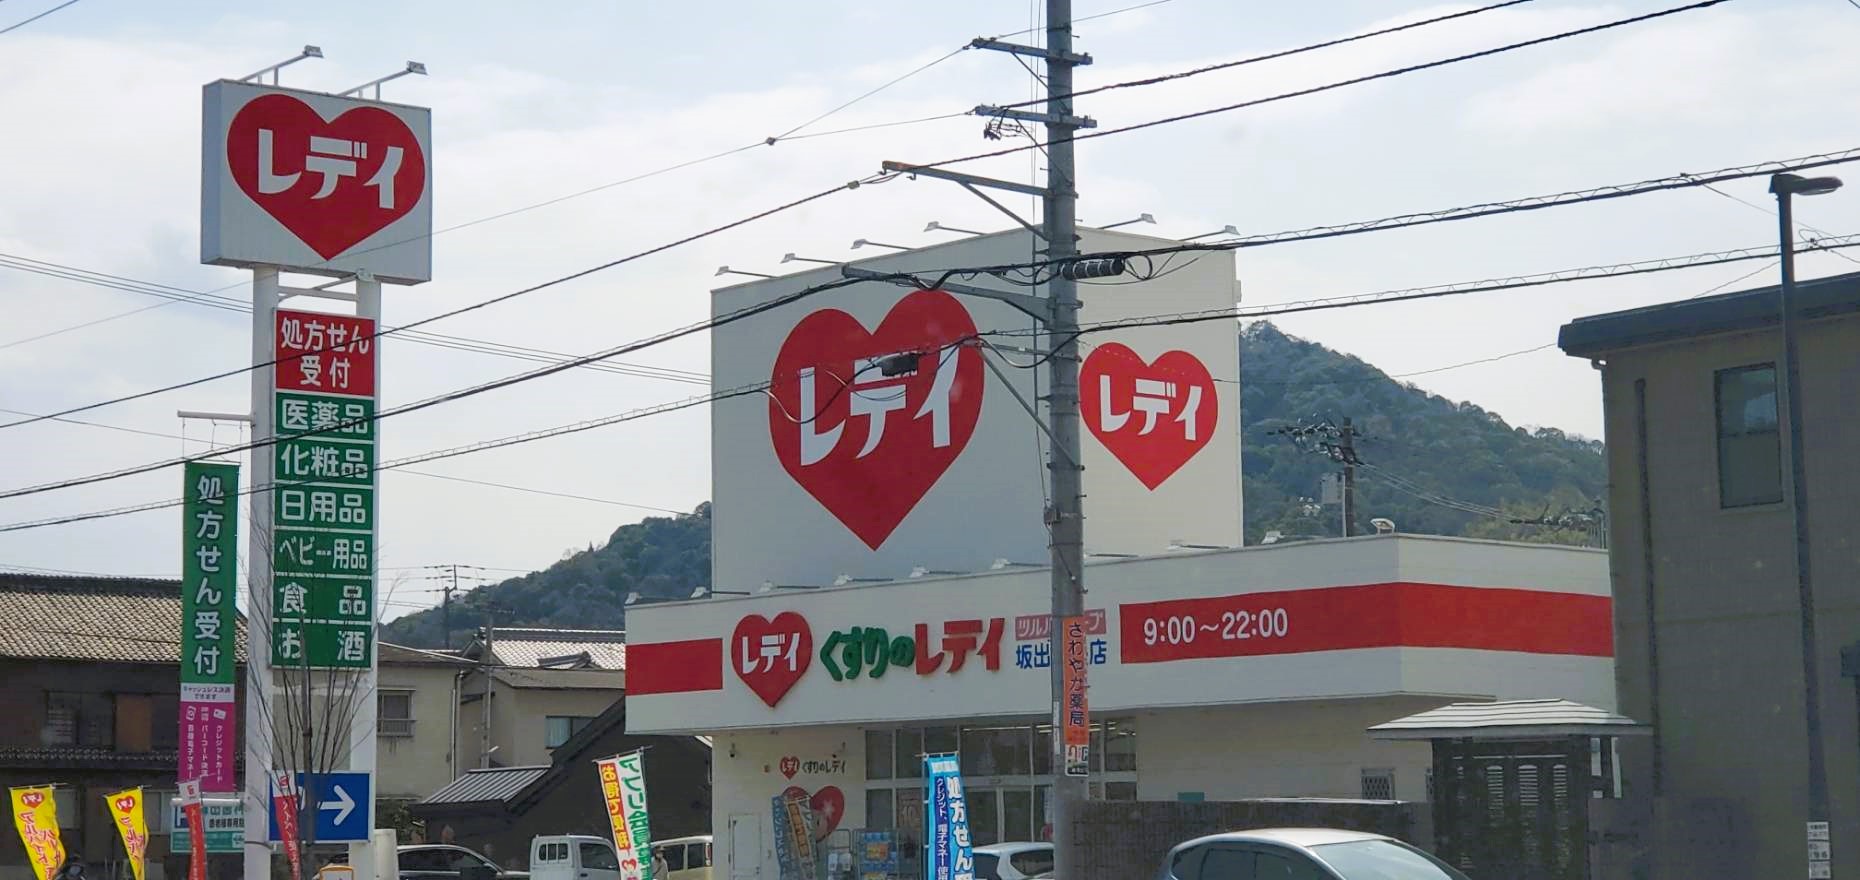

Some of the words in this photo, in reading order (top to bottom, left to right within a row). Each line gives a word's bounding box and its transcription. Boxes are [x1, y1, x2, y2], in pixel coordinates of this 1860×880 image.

[281, 317, 369, 354] 処方せん
[299, 355, 351, 389] 受付
[281, 398, 368, 434] 医薬品
[281, 444, 369, 479] 化粧品
[281, 489, 366, 524] 日用品
[279, 535, 368, 570] ベビー用品
[194, 475, 224, 675] 処方せん受付
[1068, 621, 1085, 728] さわやか薬局
